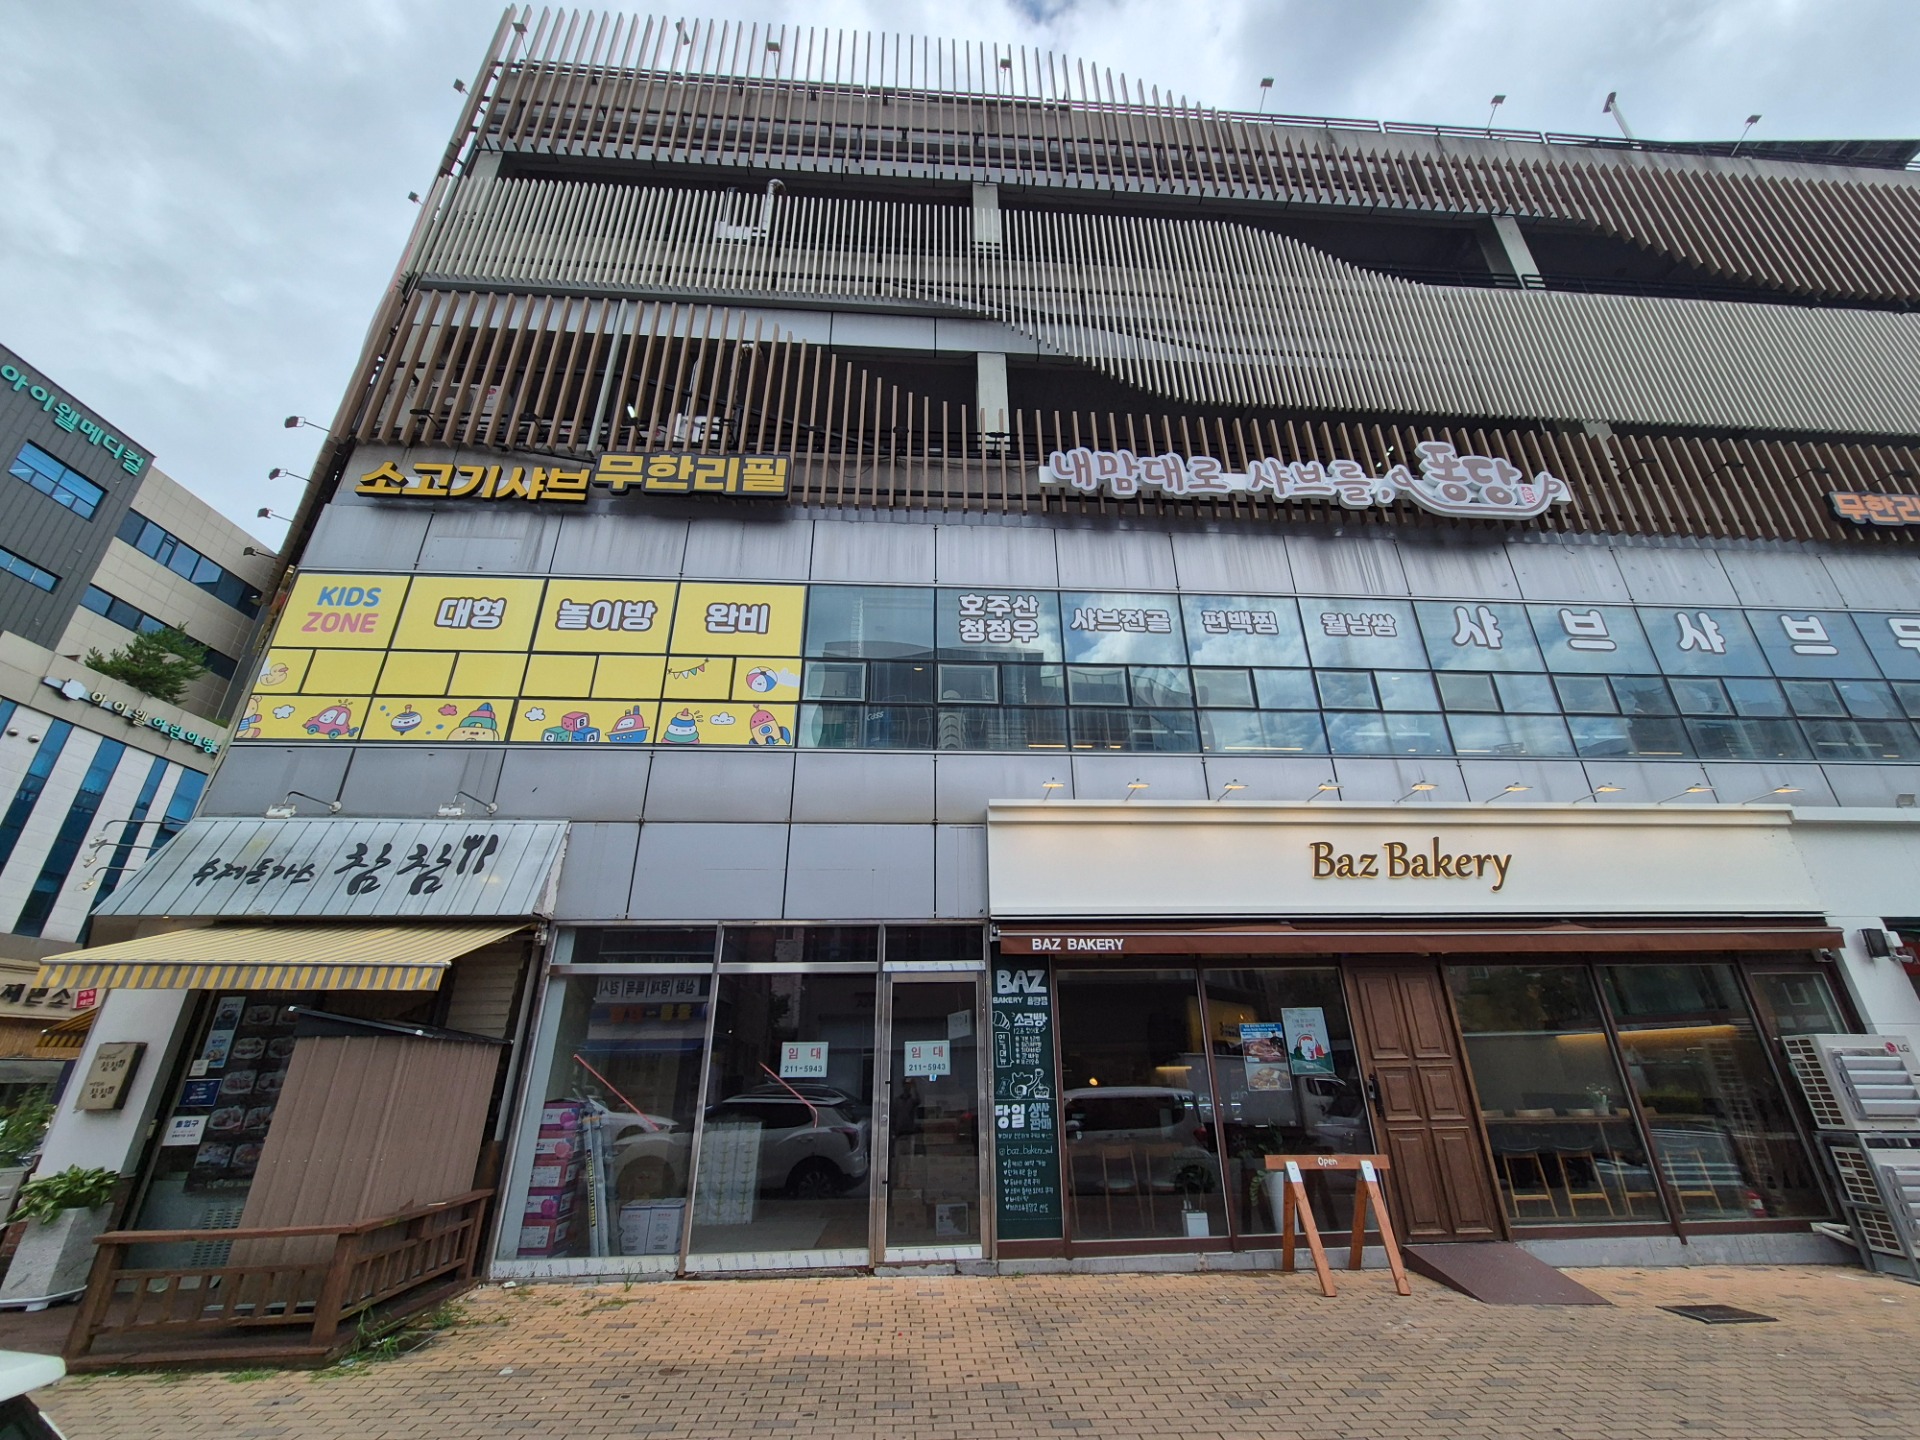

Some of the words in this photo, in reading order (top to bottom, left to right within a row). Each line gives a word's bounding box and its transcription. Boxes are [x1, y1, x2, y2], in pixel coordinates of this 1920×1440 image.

[356, 461, 591, 501] 소고기샤브
[599, 453, 787, 493] 무한리필
[1053, 448, 1230, 495] 내맘대로
[1421, 443, 1521, 504] 퐁당
[317, 586, 381, 607] KIDS
[960, 593, 1039, 619] 호주산
[302, 612, 379, 633] ZONE
[435, 597, 506, 629] 대형
[556, 598, 657, 632] 놀이방
[705, 602, 770, 633] 완비
[1070, 607, 1171, 633] 샤브전골
[1202, 609, 1279, 635] 편백찜
[1321, 612, 1397, 637] 월남쌈
[960, 617, 1039, 643] 청정우
[152, 717, 221, 753] 어린이병
[1309, 841, 1380, 879] Baz
[1383, 836, 1513, 892] Bakery
[1032, 938, 1062, 950] BAZ
[1067, 938, 1124, 950] BAKERY
[996, 969, 1047, 994] BAZ
[992, 996, 1023, 1004] BAKERY
[1014, 1012, 1048, 1027] 소금빵
[1896, 1044, 1910, 1053] LG
[784, 1064, 823, 1073] 211-5943
[908, 1063, 946, 1072] 211-5943
[995, 1104, 1026, 1129] 당일
[1028, 1102, 1050, 1118] 생산
[1317, 1157, 1338, 1167] Open
